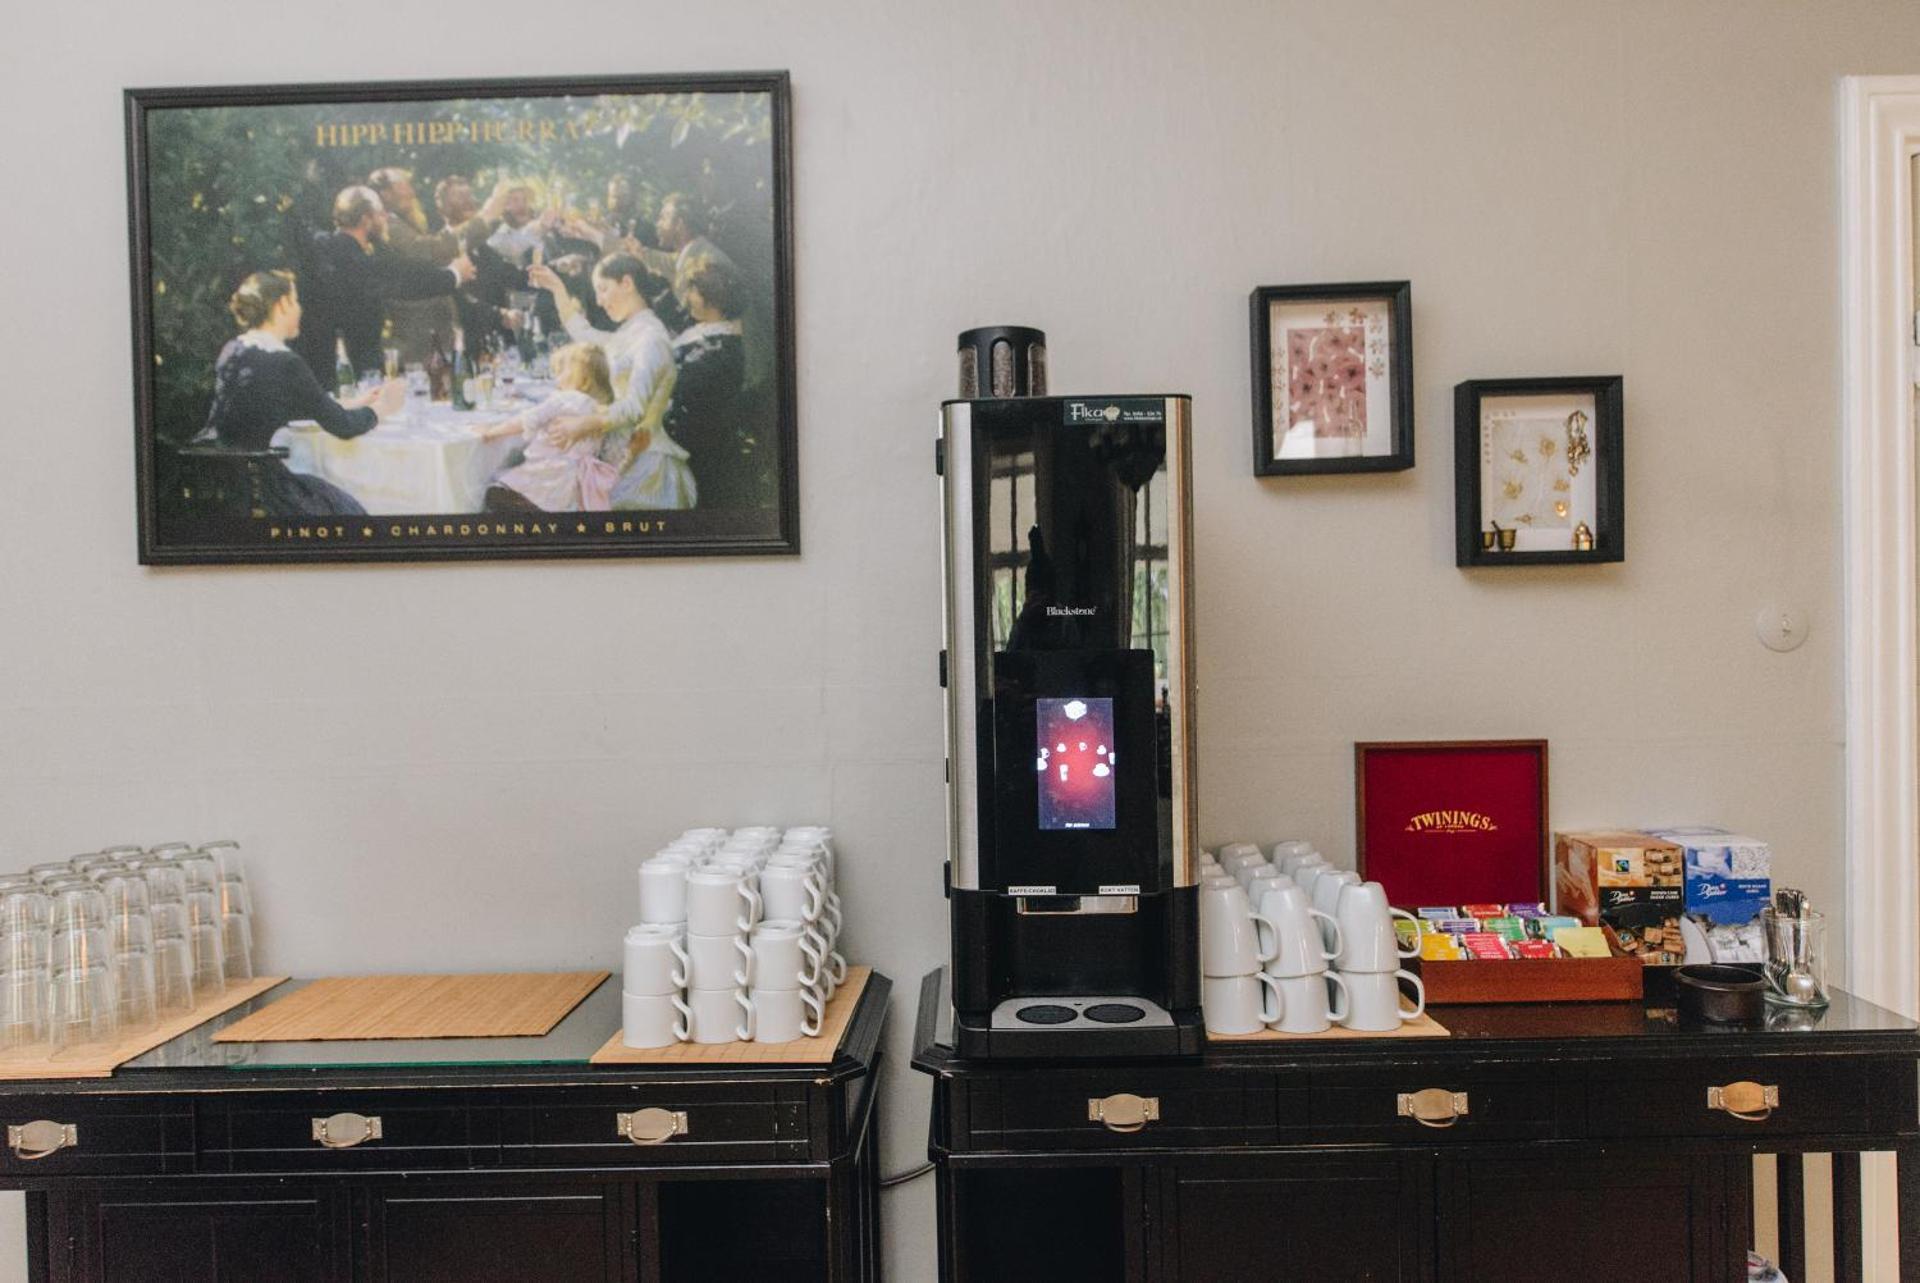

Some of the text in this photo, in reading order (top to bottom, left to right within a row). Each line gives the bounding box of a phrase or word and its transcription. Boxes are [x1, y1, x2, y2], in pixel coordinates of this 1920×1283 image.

[316, 121, 386, 146] HIPP
[391, 120, 463, 145] HIPP
[270, 521, 666, 538] PINOT CHARDONNAY BRUT
[1411, 810, 1490, 831] TWININGS
